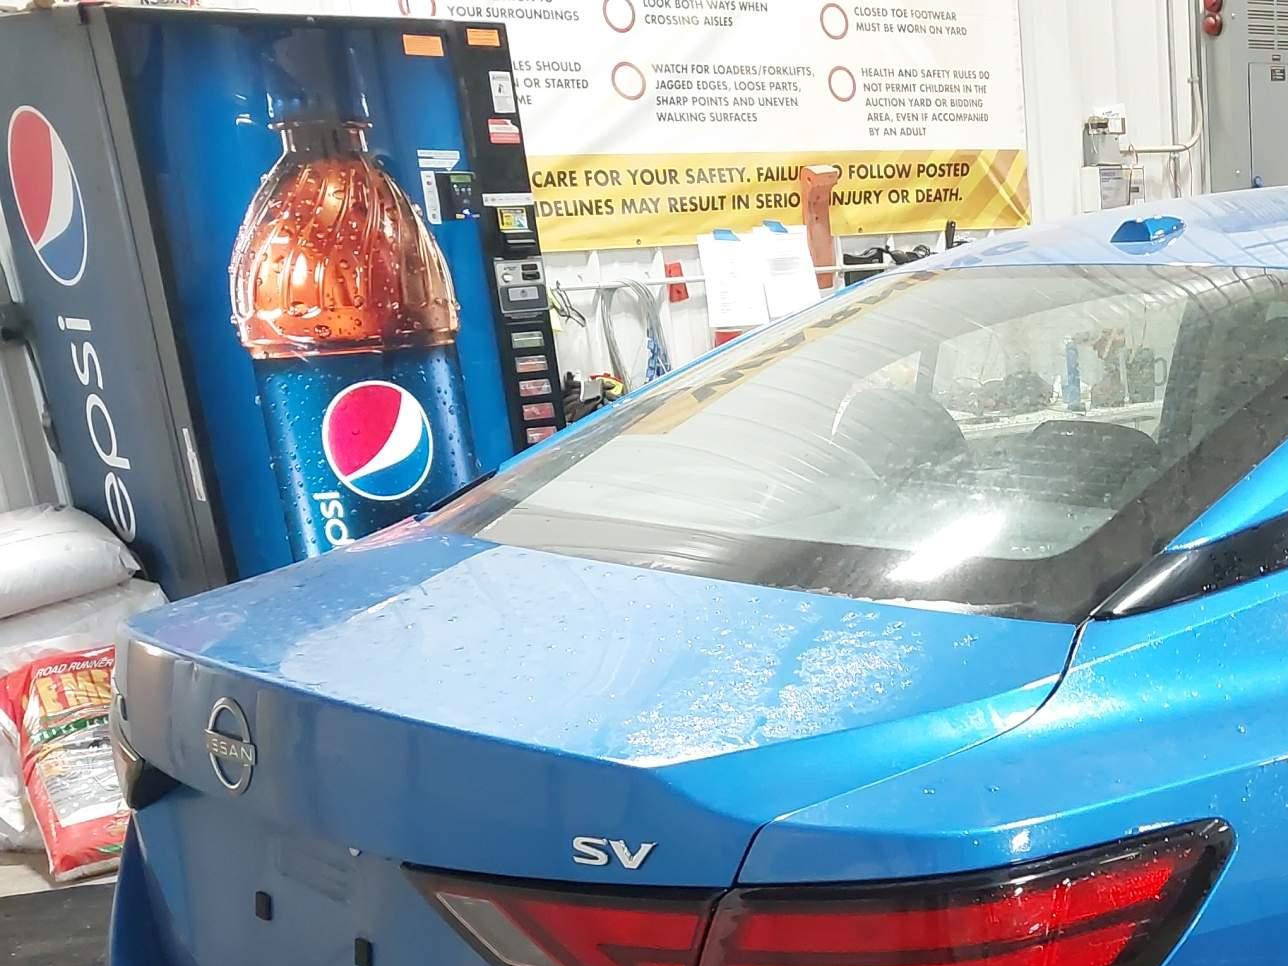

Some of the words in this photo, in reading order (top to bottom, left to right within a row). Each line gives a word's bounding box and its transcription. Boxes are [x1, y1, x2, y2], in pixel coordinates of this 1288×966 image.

[643, 0, 671, 8] LOOK
[675, 0, 703, 9] BOTH
[706, 0, 736, 10] WAYS
[740, 2, 768, 12] WHEN
[447, 6, 482, 18] YOUR
[486, 7, 580, 21] SURROUNDINGS
[854, 6, 888, 17] CLOSED
[891, 8, 908, 18] TOE
[910, 9, 957, 21] FOOTWEAR
[644, 14, 700, 25] CROSSING
[704, 16, 733, 27] AISLES
[856, 22, 881, 32] MUST
[883, 23, 894, 33] BE
[897, 24, 927, 34] WORN
[929, 25, 943, 35] ON
[945, 26, 967, 36] YARD
[512, 60, 532, 71] LES
[536, 61, 581, 72] SHOULD
[651, 63, 688, 74] WATCH
[691, 64, 710, 75] FOR
[713, 65, 815, 77] LOADERS/FORKLIFTS,
[861, 67, 894, 78] HEALTH
[898, 68, 918, 78] AND
[921, 69, 950, 79] SAFETY
[953, 70, 977, 80] RULES
[979, 70, 990, 80] DO
[524, 77, 541, 88] OR
[545, 78, 589, 89] STARTED
[655, 80, 693, 90] JAGGED
[696, 80, 731, 92] EDGES,
[734, 81, 767, 91] LOOSE
[769, 81, 801, 93] PARTS,
[863, 83, 882, 92] NOT
[885, 83, 917, 92] PERMIT
[920, 83, 960, 93] CHILDREN
[963, 84, 972, 93] IN
[974, 84, 987, 94] THE
[656, 96, 688, 106] SHARP
[691, 96, 729, 106] POINTS
[733, 96, 755, 106] AND
[758, 97, 799, 107] UNEVEN
[865, 98, 906, 107] AUCTION
[908, 98, 932, 107] YARD
[935, 98, 947, 107] OR
[950, 99, 983, 108] BIDDING
[656, 112, 706, 122] WALKING
[709, 112, 758, 122] SURFACES
[867, 112, 893, 122] AREA,
[896, 113, 918, 121] EVEN
[921, 113, 928, 121] IF
[931, 113, 989, 122] ACCOMPANIED
[869, 127, 880, 136] BY
[883, 127, 897, 136] AN
[900, 127, 926, 136] ADULT
[532, 170, 577, 188] CARE
[584, 169, 622, 187] FOR
[627, 168, 680, 186] YOUR
[686, 167, 751, 185] SAFETY.
[757, 165, 803, 182] FAILU
[849, 164, 912, 180] FOLLOW
[917, 163, 970, 179] POSTED
[535, 199, 614, 218] IDELINES
[621, 197, 660, 215] MAY
[668, 195, 726, 213] RESULT
[732, 194, 750, 211] IN
[756, 192, 801, 209] SERIO
[828, 189, 882, 206] INJURY
[887, 189, 911, 204] OR
[915, 188, 963, 203] DEATH.
[57, 314, 137, 543] epsi
[312, 492, 355, 546] psi
[35, 663, 67, 679] ROAD
[68, 657, 115, 672] RUNNER
[572, 836, 658, 869] SV
